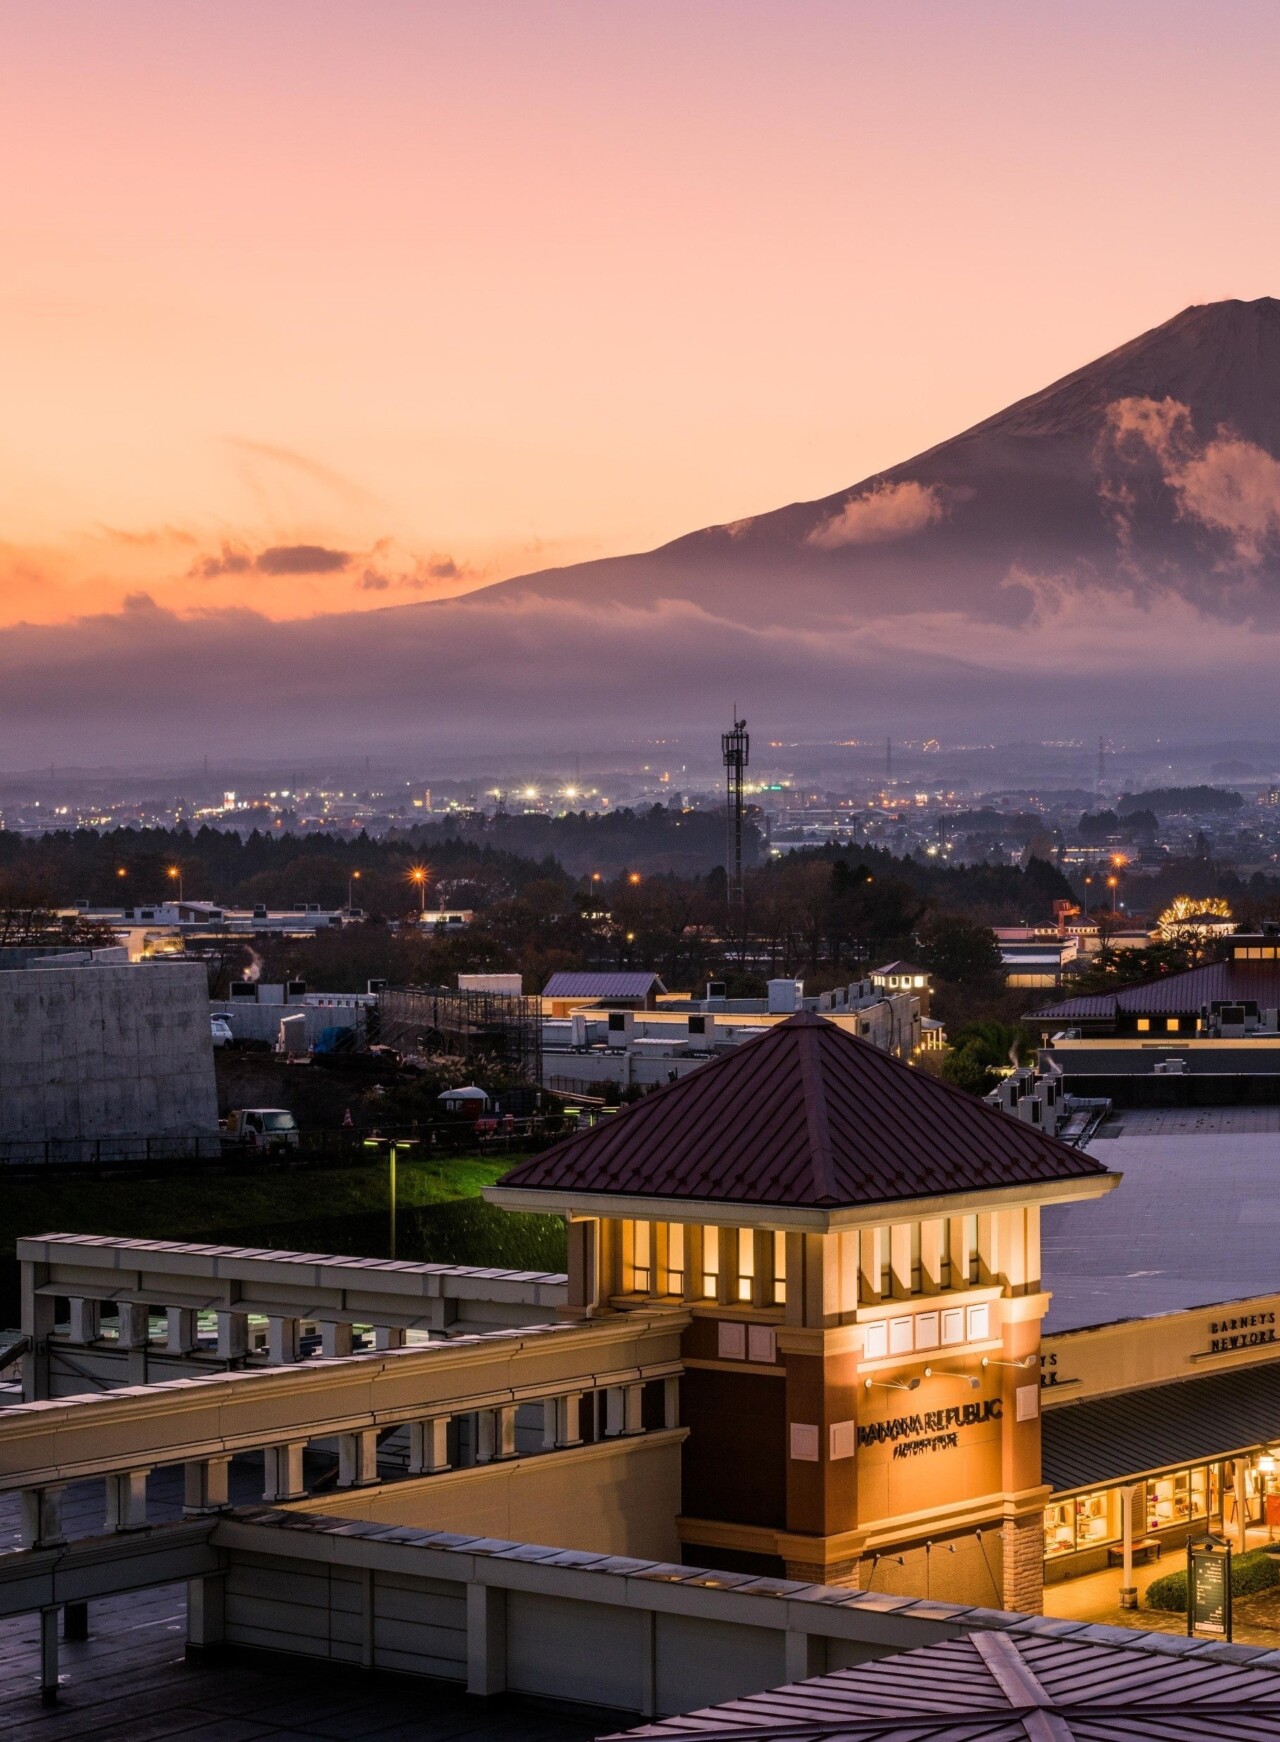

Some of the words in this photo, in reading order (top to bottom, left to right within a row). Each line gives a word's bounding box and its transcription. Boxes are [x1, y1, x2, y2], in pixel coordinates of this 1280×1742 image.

[1210, 1312, 1275, 1334] BARNEYS
[858, 1414, 923, 1446] BANANA
[924, 1398, 1003, 1434] REPUBLIC
